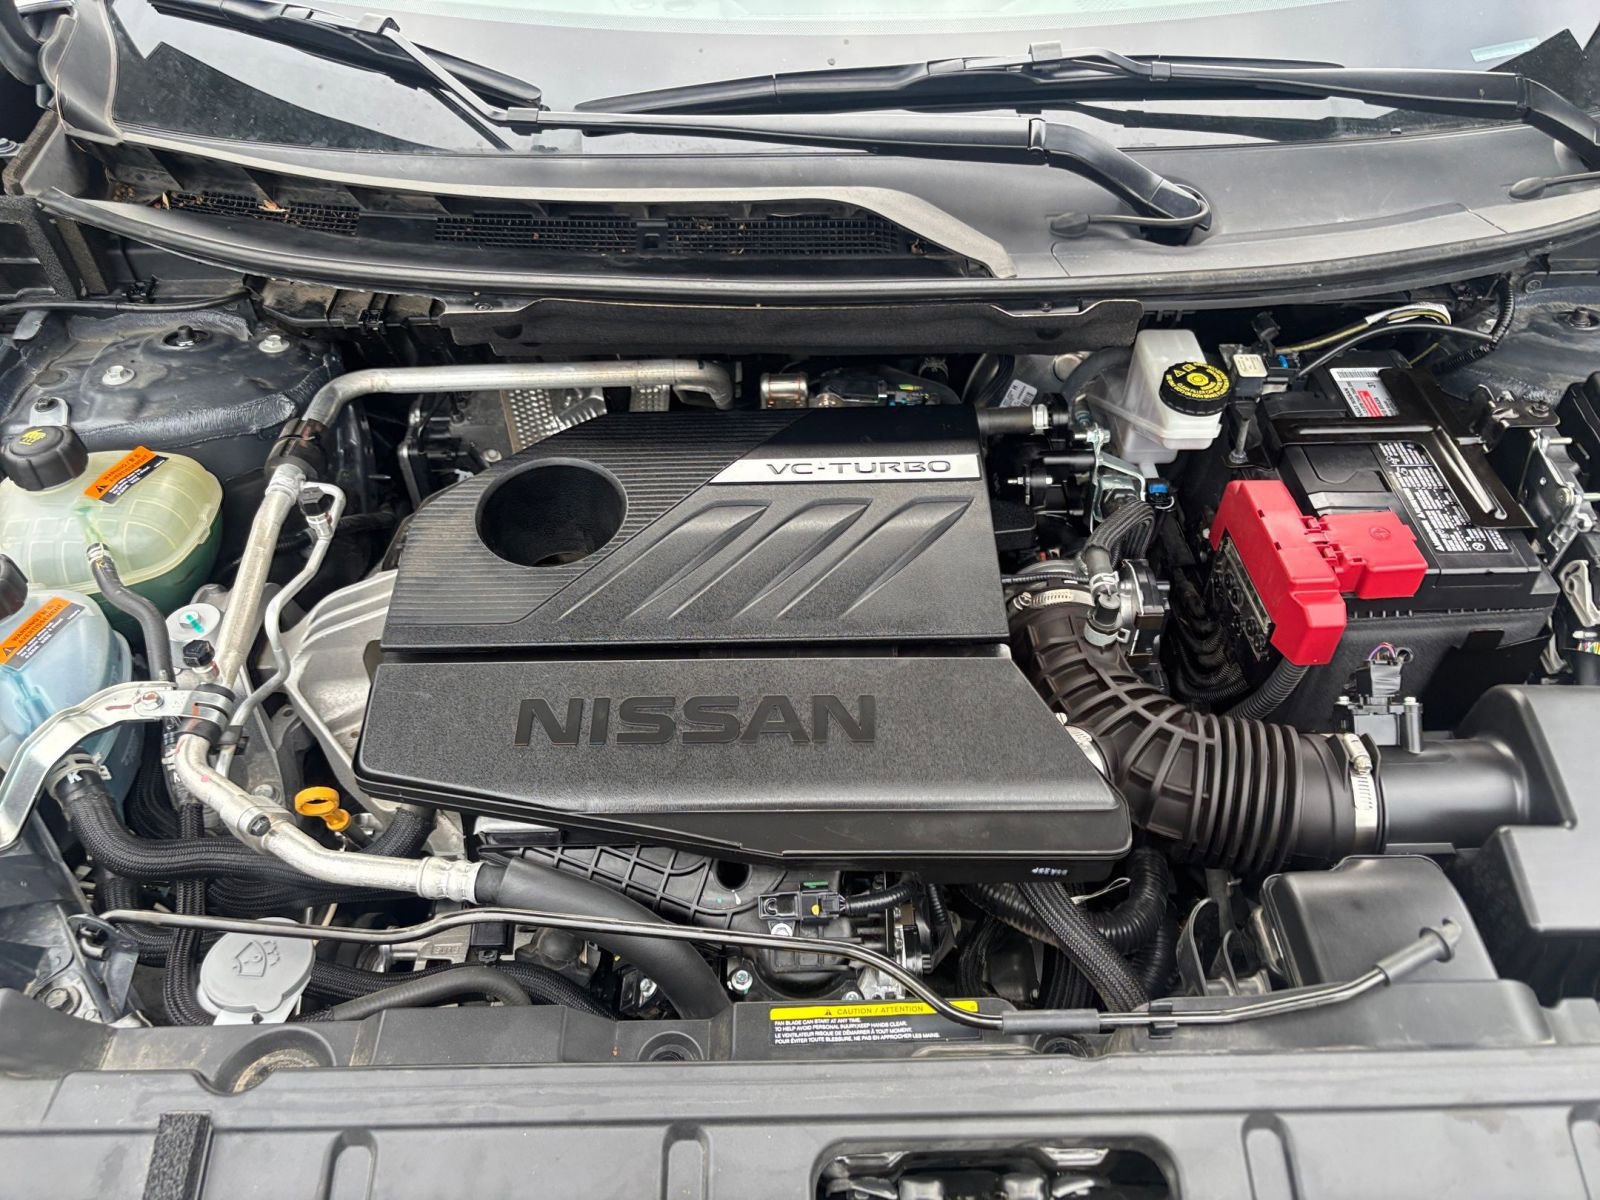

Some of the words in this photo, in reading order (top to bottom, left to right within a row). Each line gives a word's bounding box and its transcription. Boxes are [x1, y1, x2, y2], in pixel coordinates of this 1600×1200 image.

[766, 460, 952, 476] VC-TURBO
[11, 617, 38, 641] WARNING
[513, 694, 877, 747] NISSAN
[66, 771, 83, 784] K
[837, 1008, 872, 1016] CAUTION
[881, 1005, 924, 1014] ATTENTION
